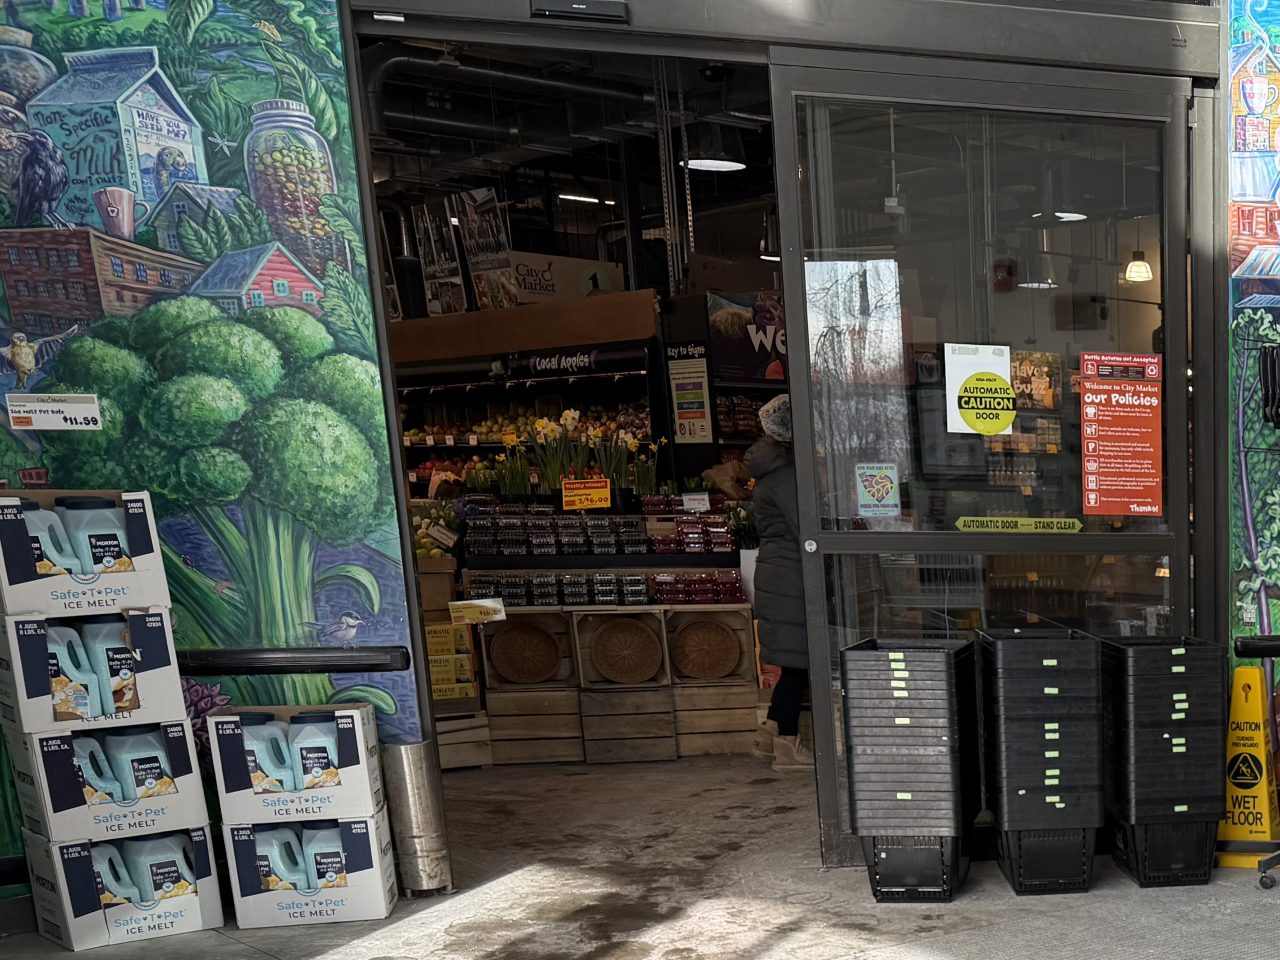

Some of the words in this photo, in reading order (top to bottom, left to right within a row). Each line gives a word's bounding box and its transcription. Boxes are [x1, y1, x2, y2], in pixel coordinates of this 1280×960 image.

[137, 110, 160, 123] HAVE
[516, 263, 541, 277] City
[536, 354, 559, 371] Local
[560, 352, 589, 372] Apples
[963, 387, 1010, 395] AUTOMATIC
[1084, 382, 1112, 390] Welcome
[1121, 384, 1135, 392] City
[961, 397, 1013, 409] CAUTION
[1084, 393, 1107, 404] Our
[1111, 393, 1158, 407] Policies
[62, 415, 98, 426] $11.59
[1129, 504, 1159, 512] Thanks!
[963, 520, 999, 528] AUTOMATIC
[1001, 520, 1019, 529] DOOR
[1034, 521, 1054, 530] STAND
[1055, 521, 1076, 530] CLEAR
[64, 601, 83, 610] ICE
[88, 599, 117, 608] MELT
[1231, 721, 1260, 732] CAUTION
[1231, 795, 1258, 810] WET
[296, 807, 322, 815] MELT
[1225, 811, 1263, 826] FLOOR
[106, 824, 125, 832] ICE
[128, 819, 157, 829] MELT
[309, 909, 336, 917] MELT
[126, 927, 144, 935] ICE
[148, 921, 175, 932] MELT
